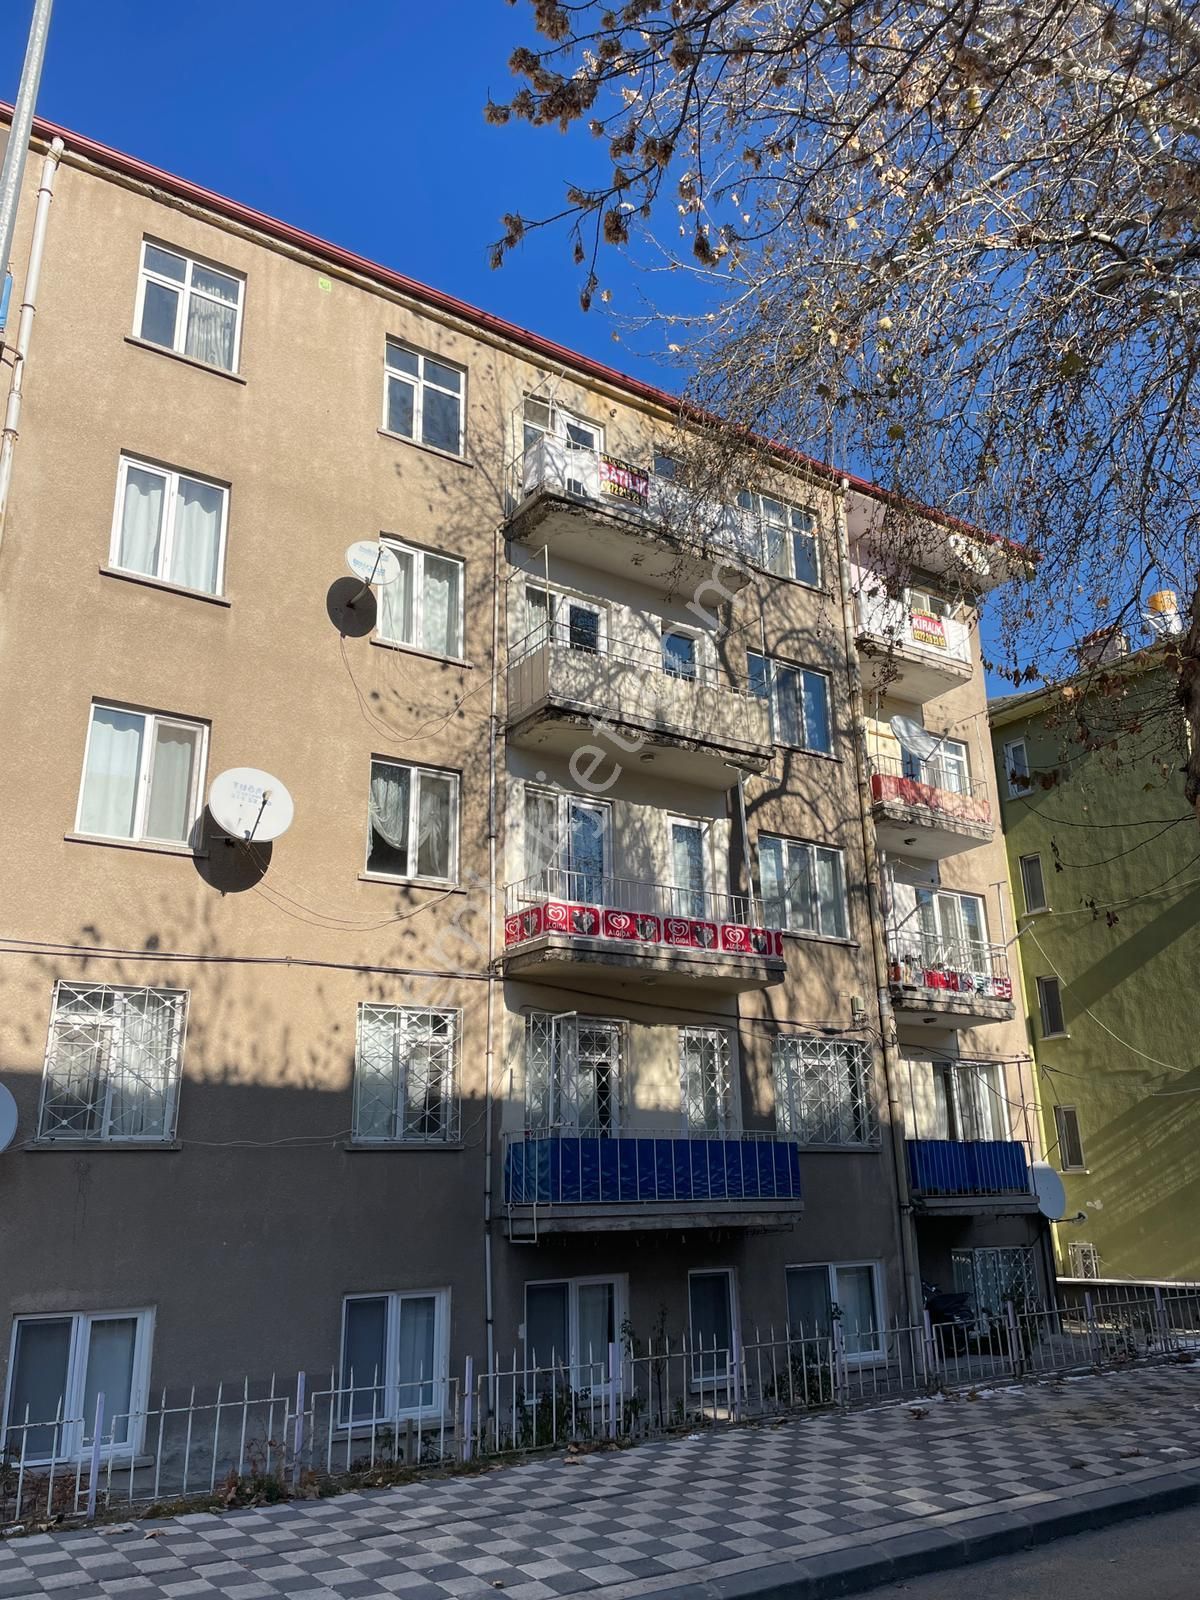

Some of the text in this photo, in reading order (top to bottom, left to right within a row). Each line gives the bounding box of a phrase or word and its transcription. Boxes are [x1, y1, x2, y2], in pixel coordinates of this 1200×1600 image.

[599, 461, 648, 498] SATILIK
[911, 617, 944, 637] KIRALIK
[546, 921, 567, 930] ALGIDA
[608, 930, 631, 938] ALGIDA
[669, 937, 689, 945] ALGIDA
[726, 943, 747, 951] ALGIDA
